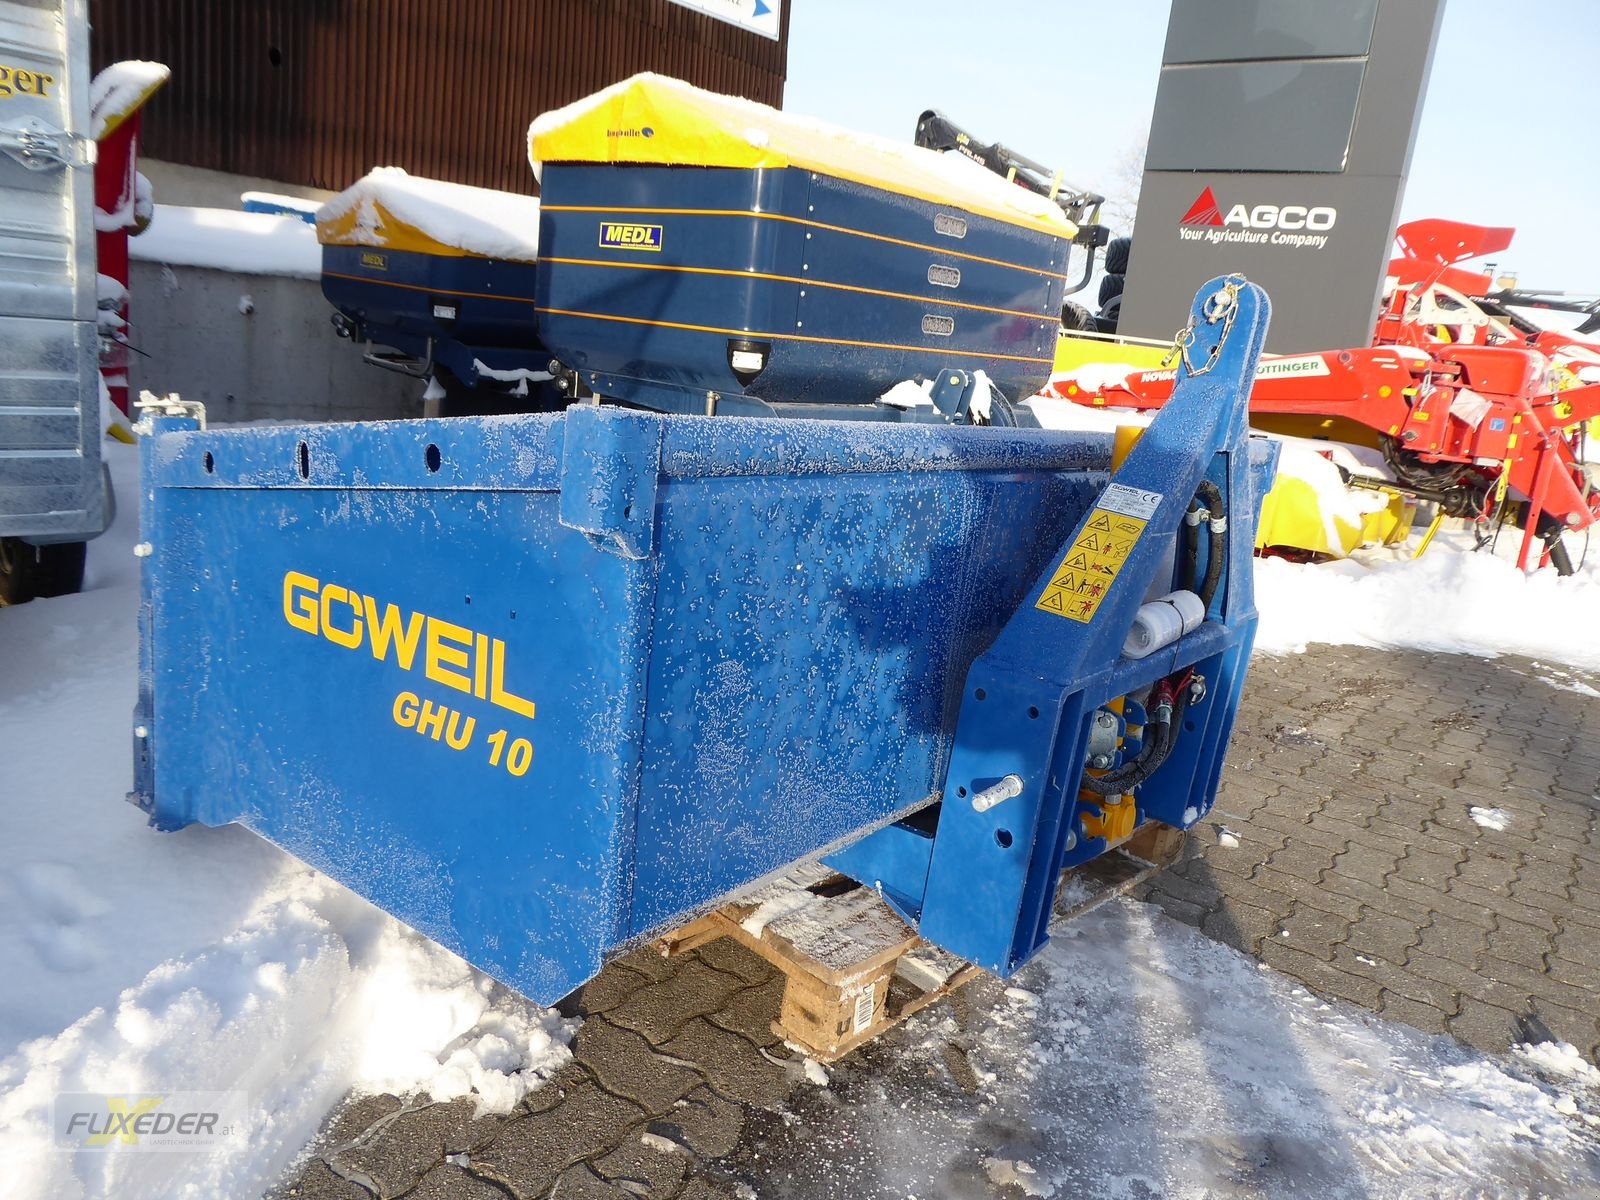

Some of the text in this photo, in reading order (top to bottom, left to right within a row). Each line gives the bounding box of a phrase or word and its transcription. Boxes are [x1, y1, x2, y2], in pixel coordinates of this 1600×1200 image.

[1224, 204, 1337, 231] AGCO
[605, 225, 655, 244] MEDL
[1179, 227, 1328, 249] Your Agriculture Company
[392, 691, 533, 777] GHU 10
